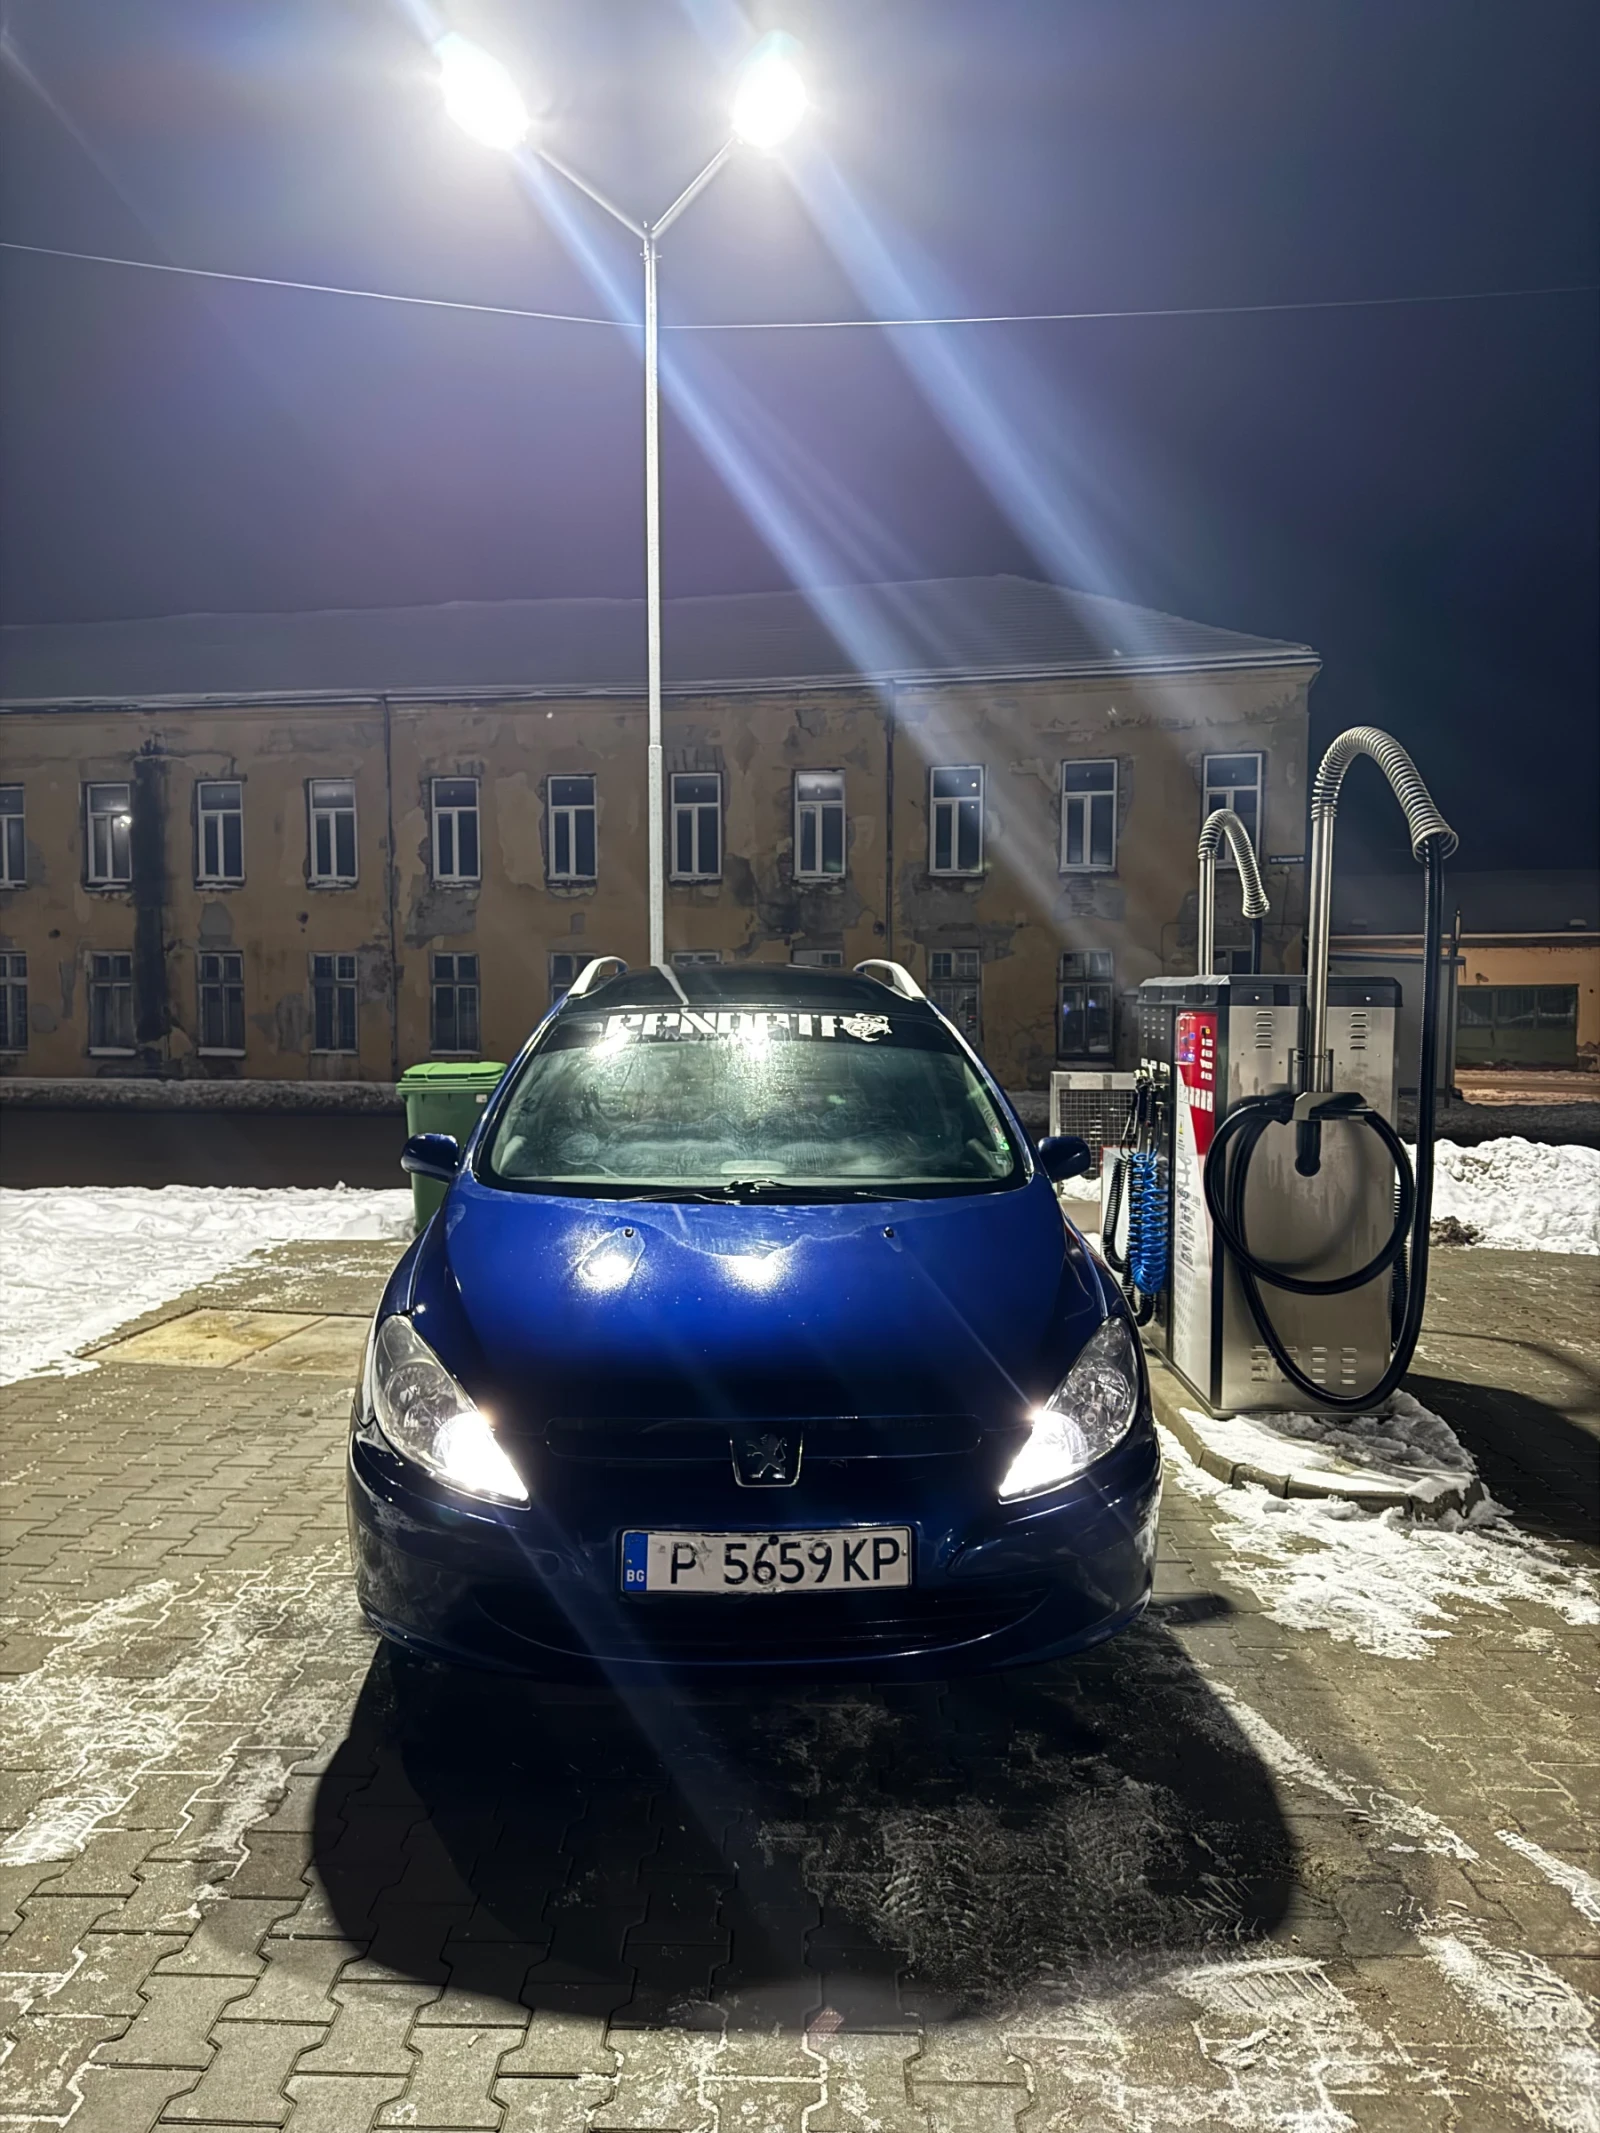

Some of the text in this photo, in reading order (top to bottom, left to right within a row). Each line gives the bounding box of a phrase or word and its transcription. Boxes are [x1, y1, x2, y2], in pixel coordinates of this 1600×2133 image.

[626, 1569, 645, 1583] BG
[670, 1536, 900, 1586] P 5659 KP
